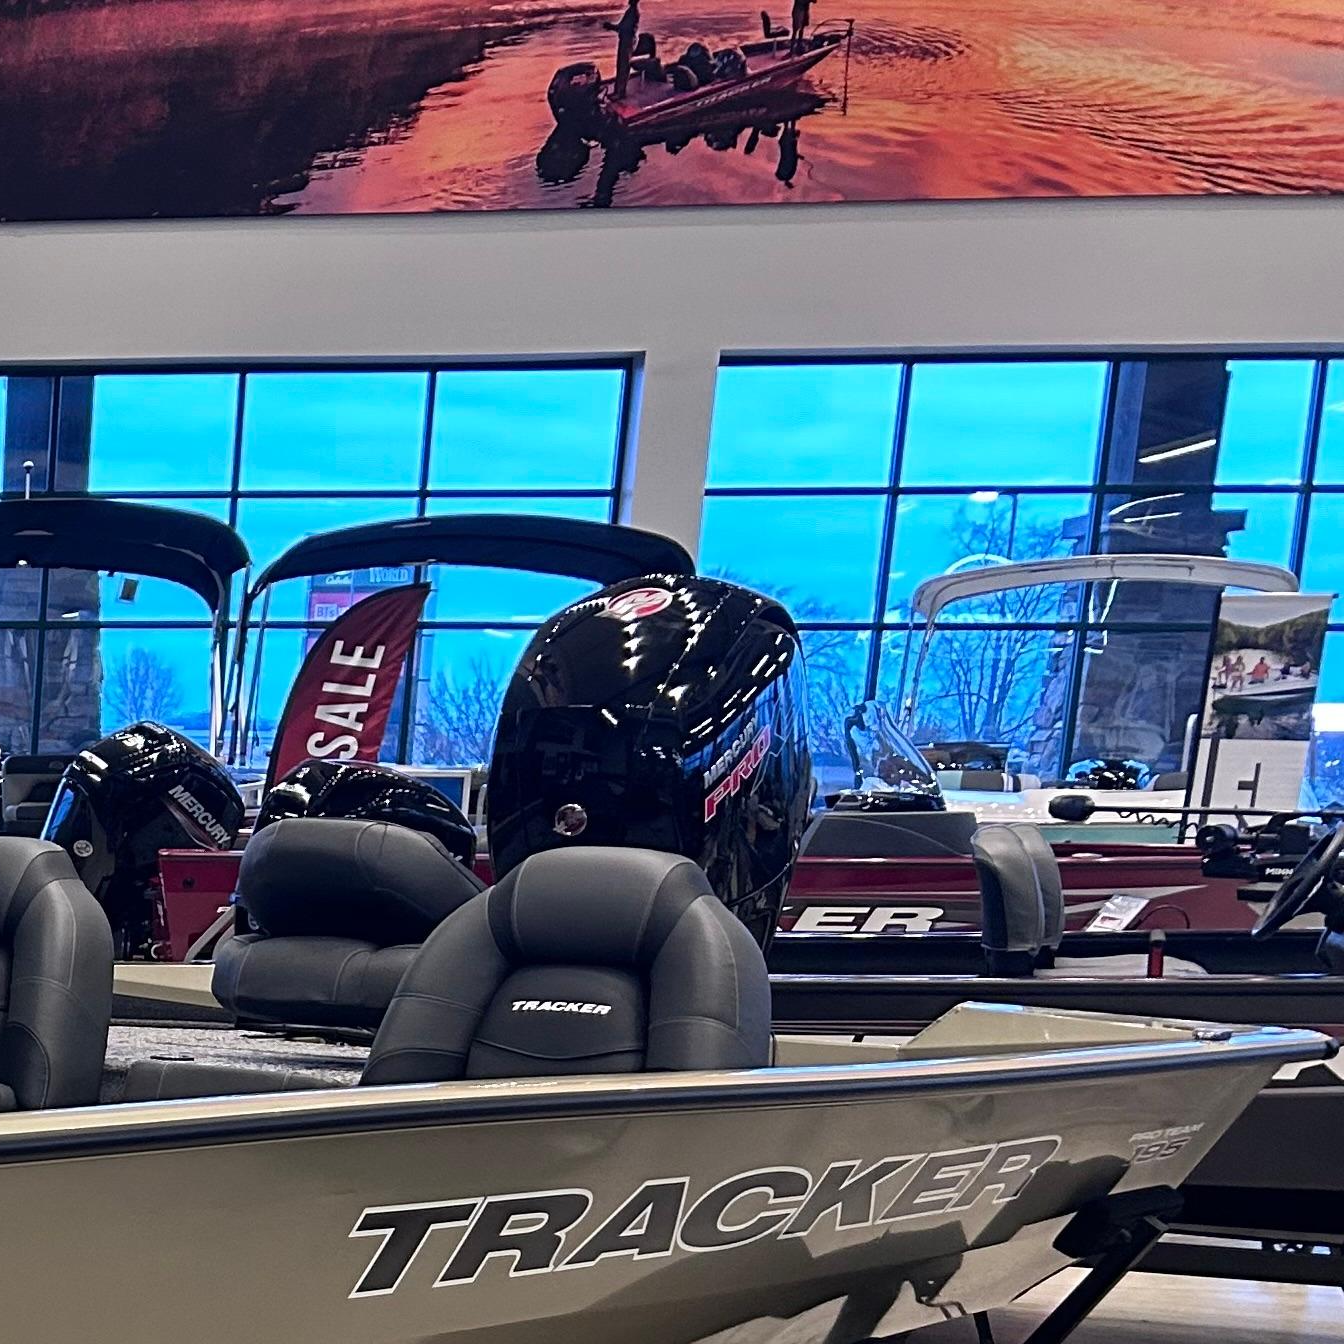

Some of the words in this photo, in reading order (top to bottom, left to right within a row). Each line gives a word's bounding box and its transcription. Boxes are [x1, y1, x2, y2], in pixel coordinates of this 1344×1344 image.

[306, 640, 386, 761] SALE
[168, 784, 232, 848] MERCURY
[704, 724, 771, 823] PRO
[512, 1000, 612, 1015] TRACKER
[347, 1134, 1063, 1301] TRACKER
